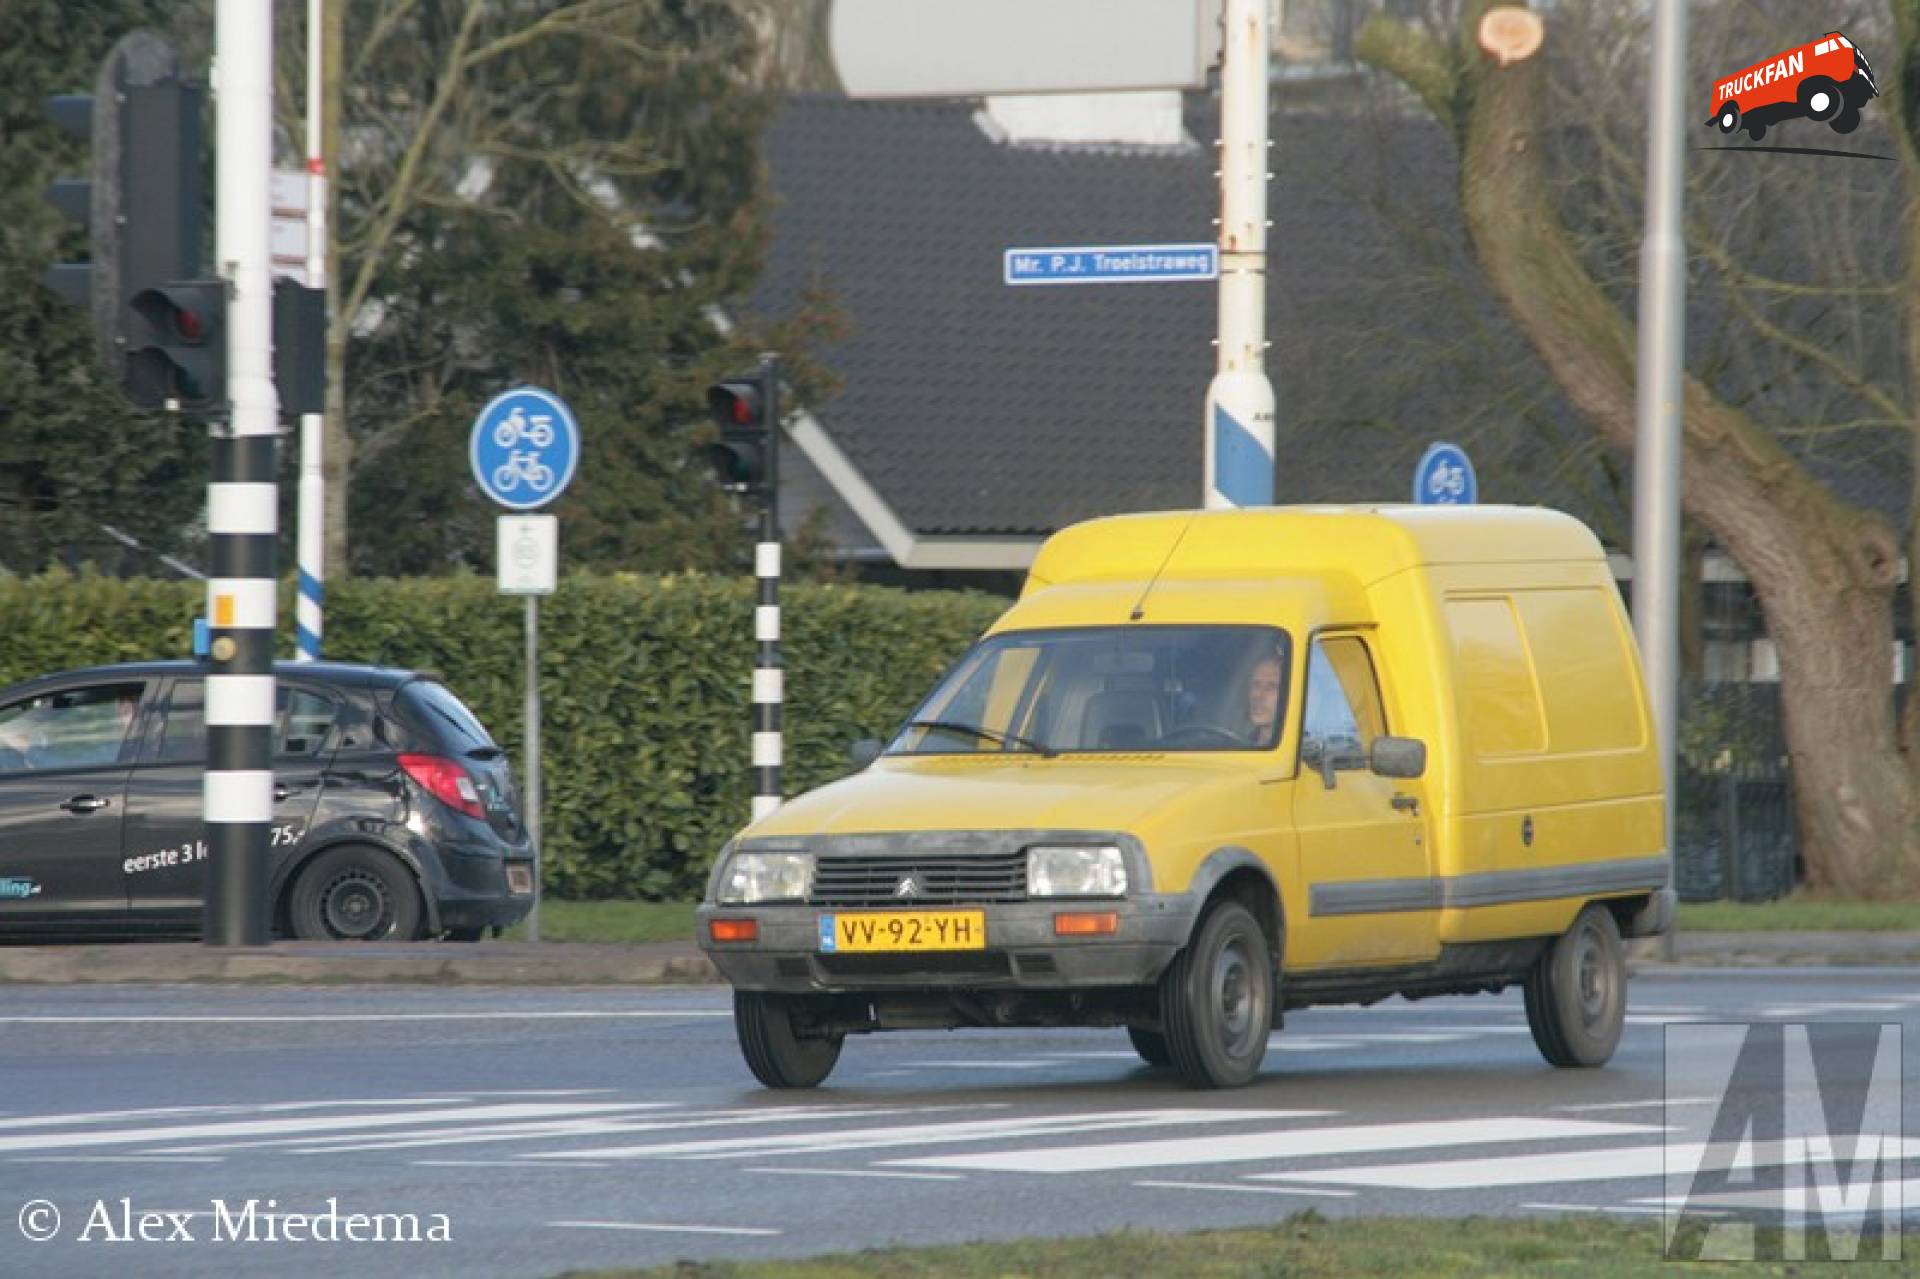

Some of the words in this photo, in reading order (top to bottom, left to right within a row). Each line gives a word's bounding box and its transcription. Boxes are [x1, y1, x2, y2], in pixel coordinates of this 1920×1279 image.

[1014, 256, 1044, 272] Mr.
[1051, 255, 1087, 272] P.J.
[1094, 253, 1208, 272] Troelstraweg
[123, 849, 178, 874] eerste
[181, 844, 193, 864] 3
[842, 918, 971, 944] VV-92-YH
